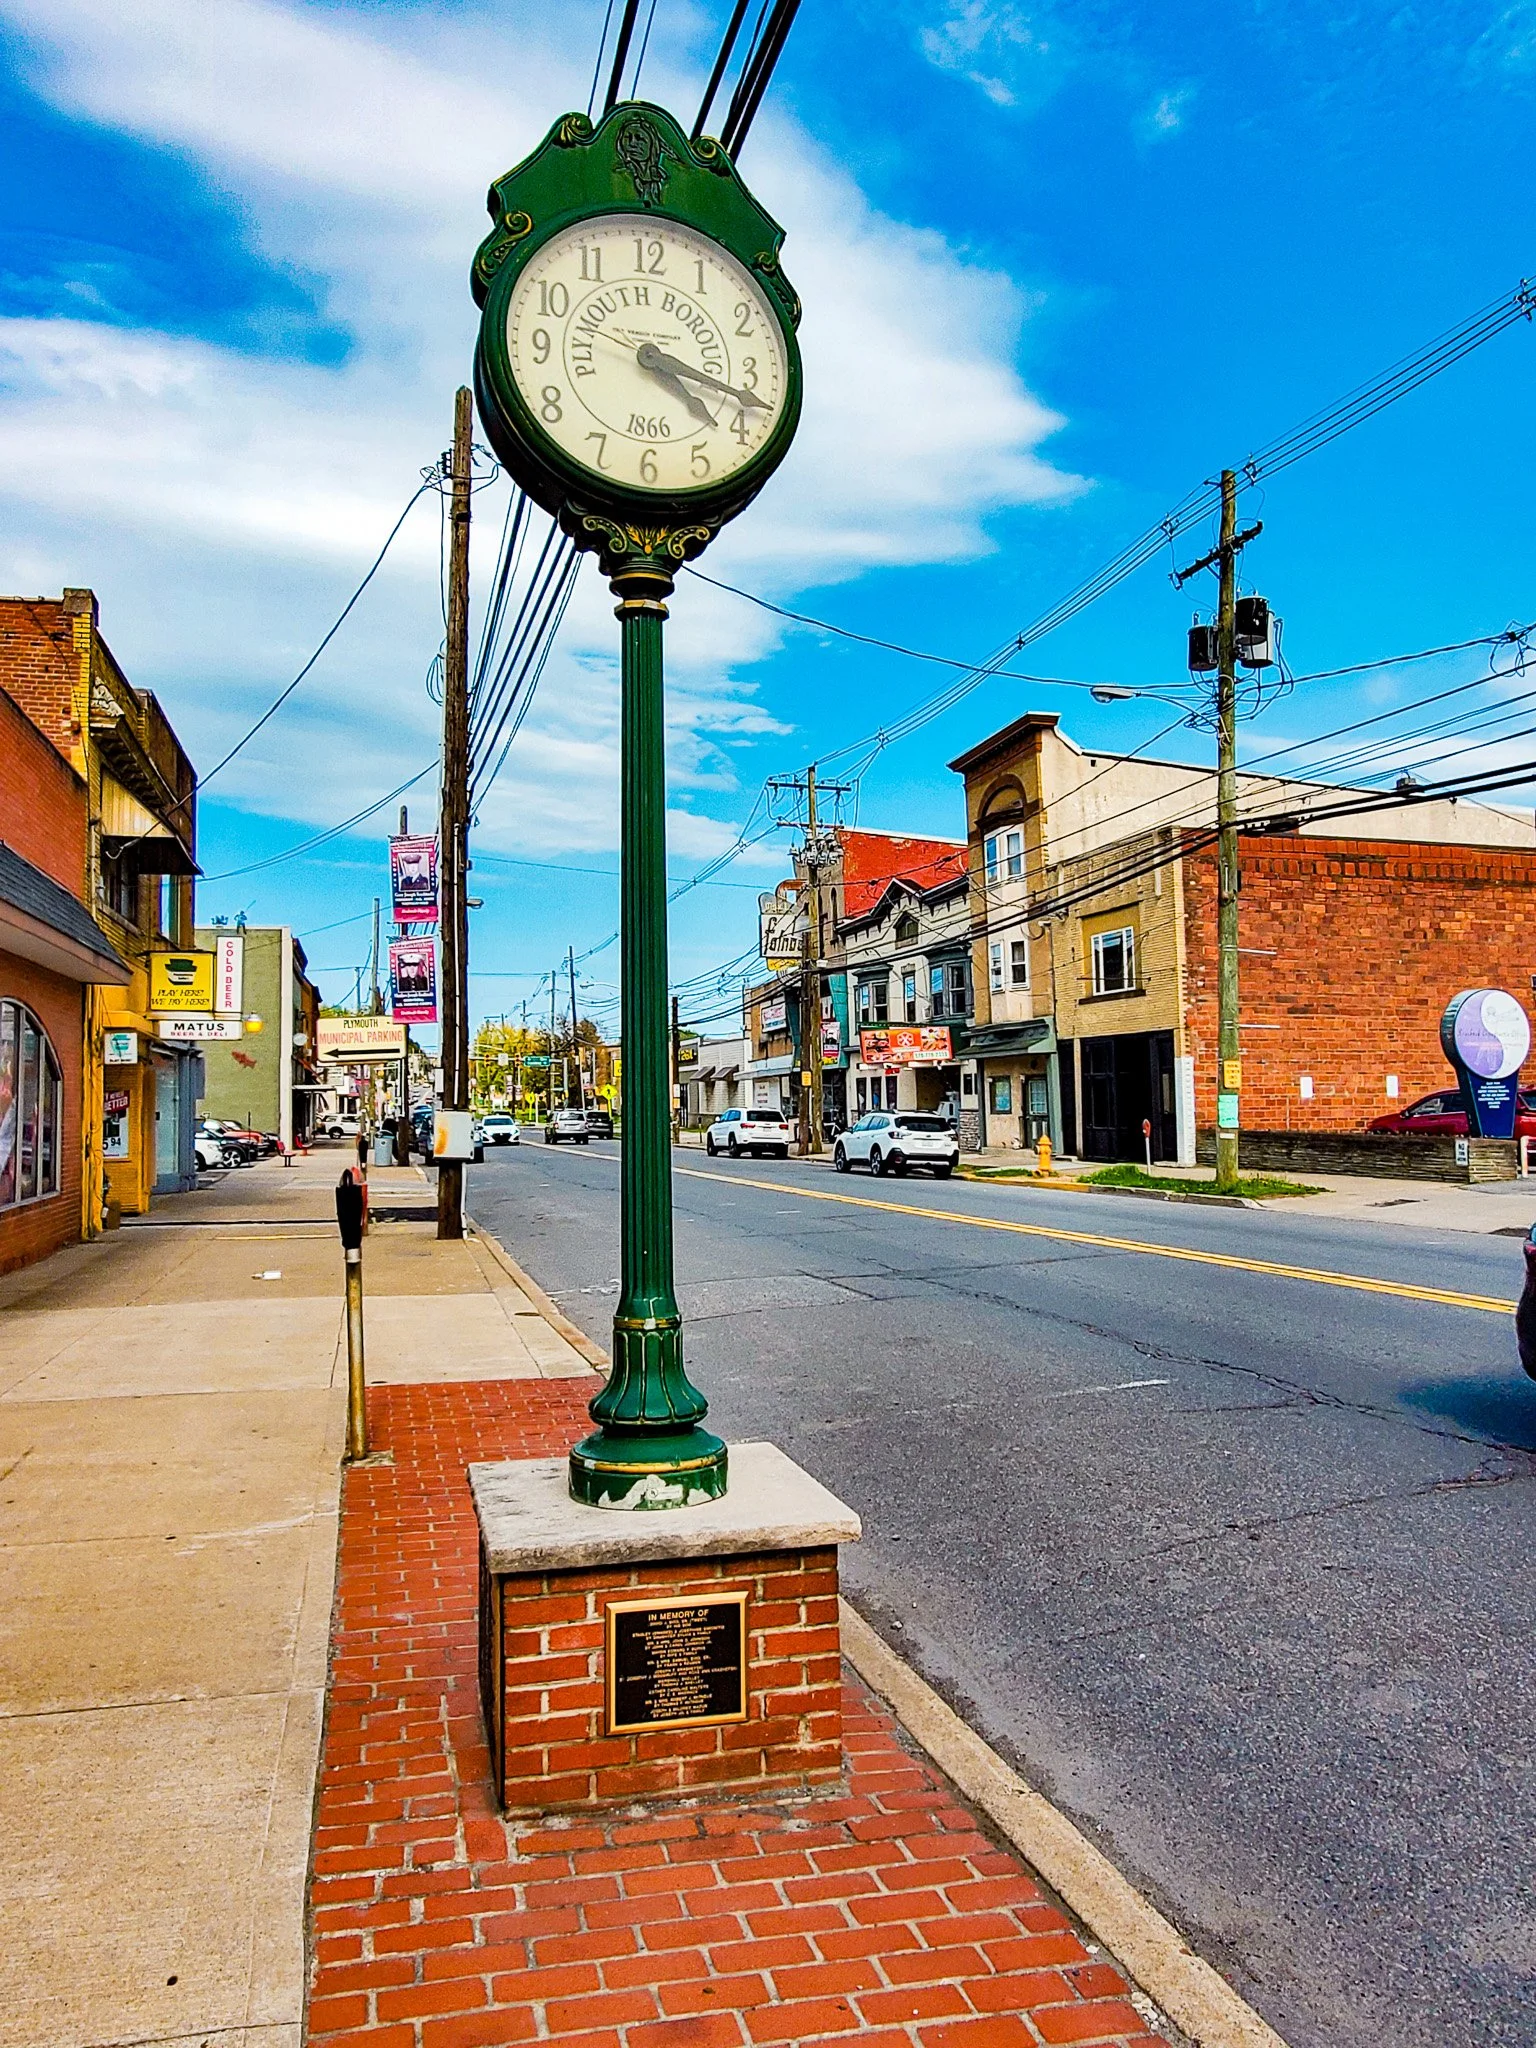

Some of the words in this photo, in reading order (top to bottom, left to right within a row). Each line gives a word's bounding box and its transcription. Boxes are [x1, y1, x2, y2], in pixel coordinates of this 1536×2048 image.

[578, 245, 604, 282] 11
[633, 237, 667, 276] 12
[694, 259, 707, 295] 1
[537, 280, 569, 318] 10
[734, 303, 755, 337] 2
[532, 328, 550, 364] 9
[572, 286, 652, 379] PLYMOUTH
[661, 291, 722, 390] BOROUG
[742, 356, 758, 391] 3
[541, 386, 562, 424] 8
[625, 413, 671, 438] 1866
[729, 409, 750, 446] 4
[584, 432, 612, 470] 7
[640, 449, 658, 484] 6
[690, 441, 711, 479] 5
[225, 941, 234, 973] COLD
[225, 976, 233, 1008] BEER
[174, 1023, 225, 1031] MATUS
[320, 1031, 364, 1044] MUNICIPAL
[367, 1031, 403, 1042] PARKING
[343, 1019, 378, 1028] PLYMOUTH
[660, 1611, 695, 1620] MEMORY
